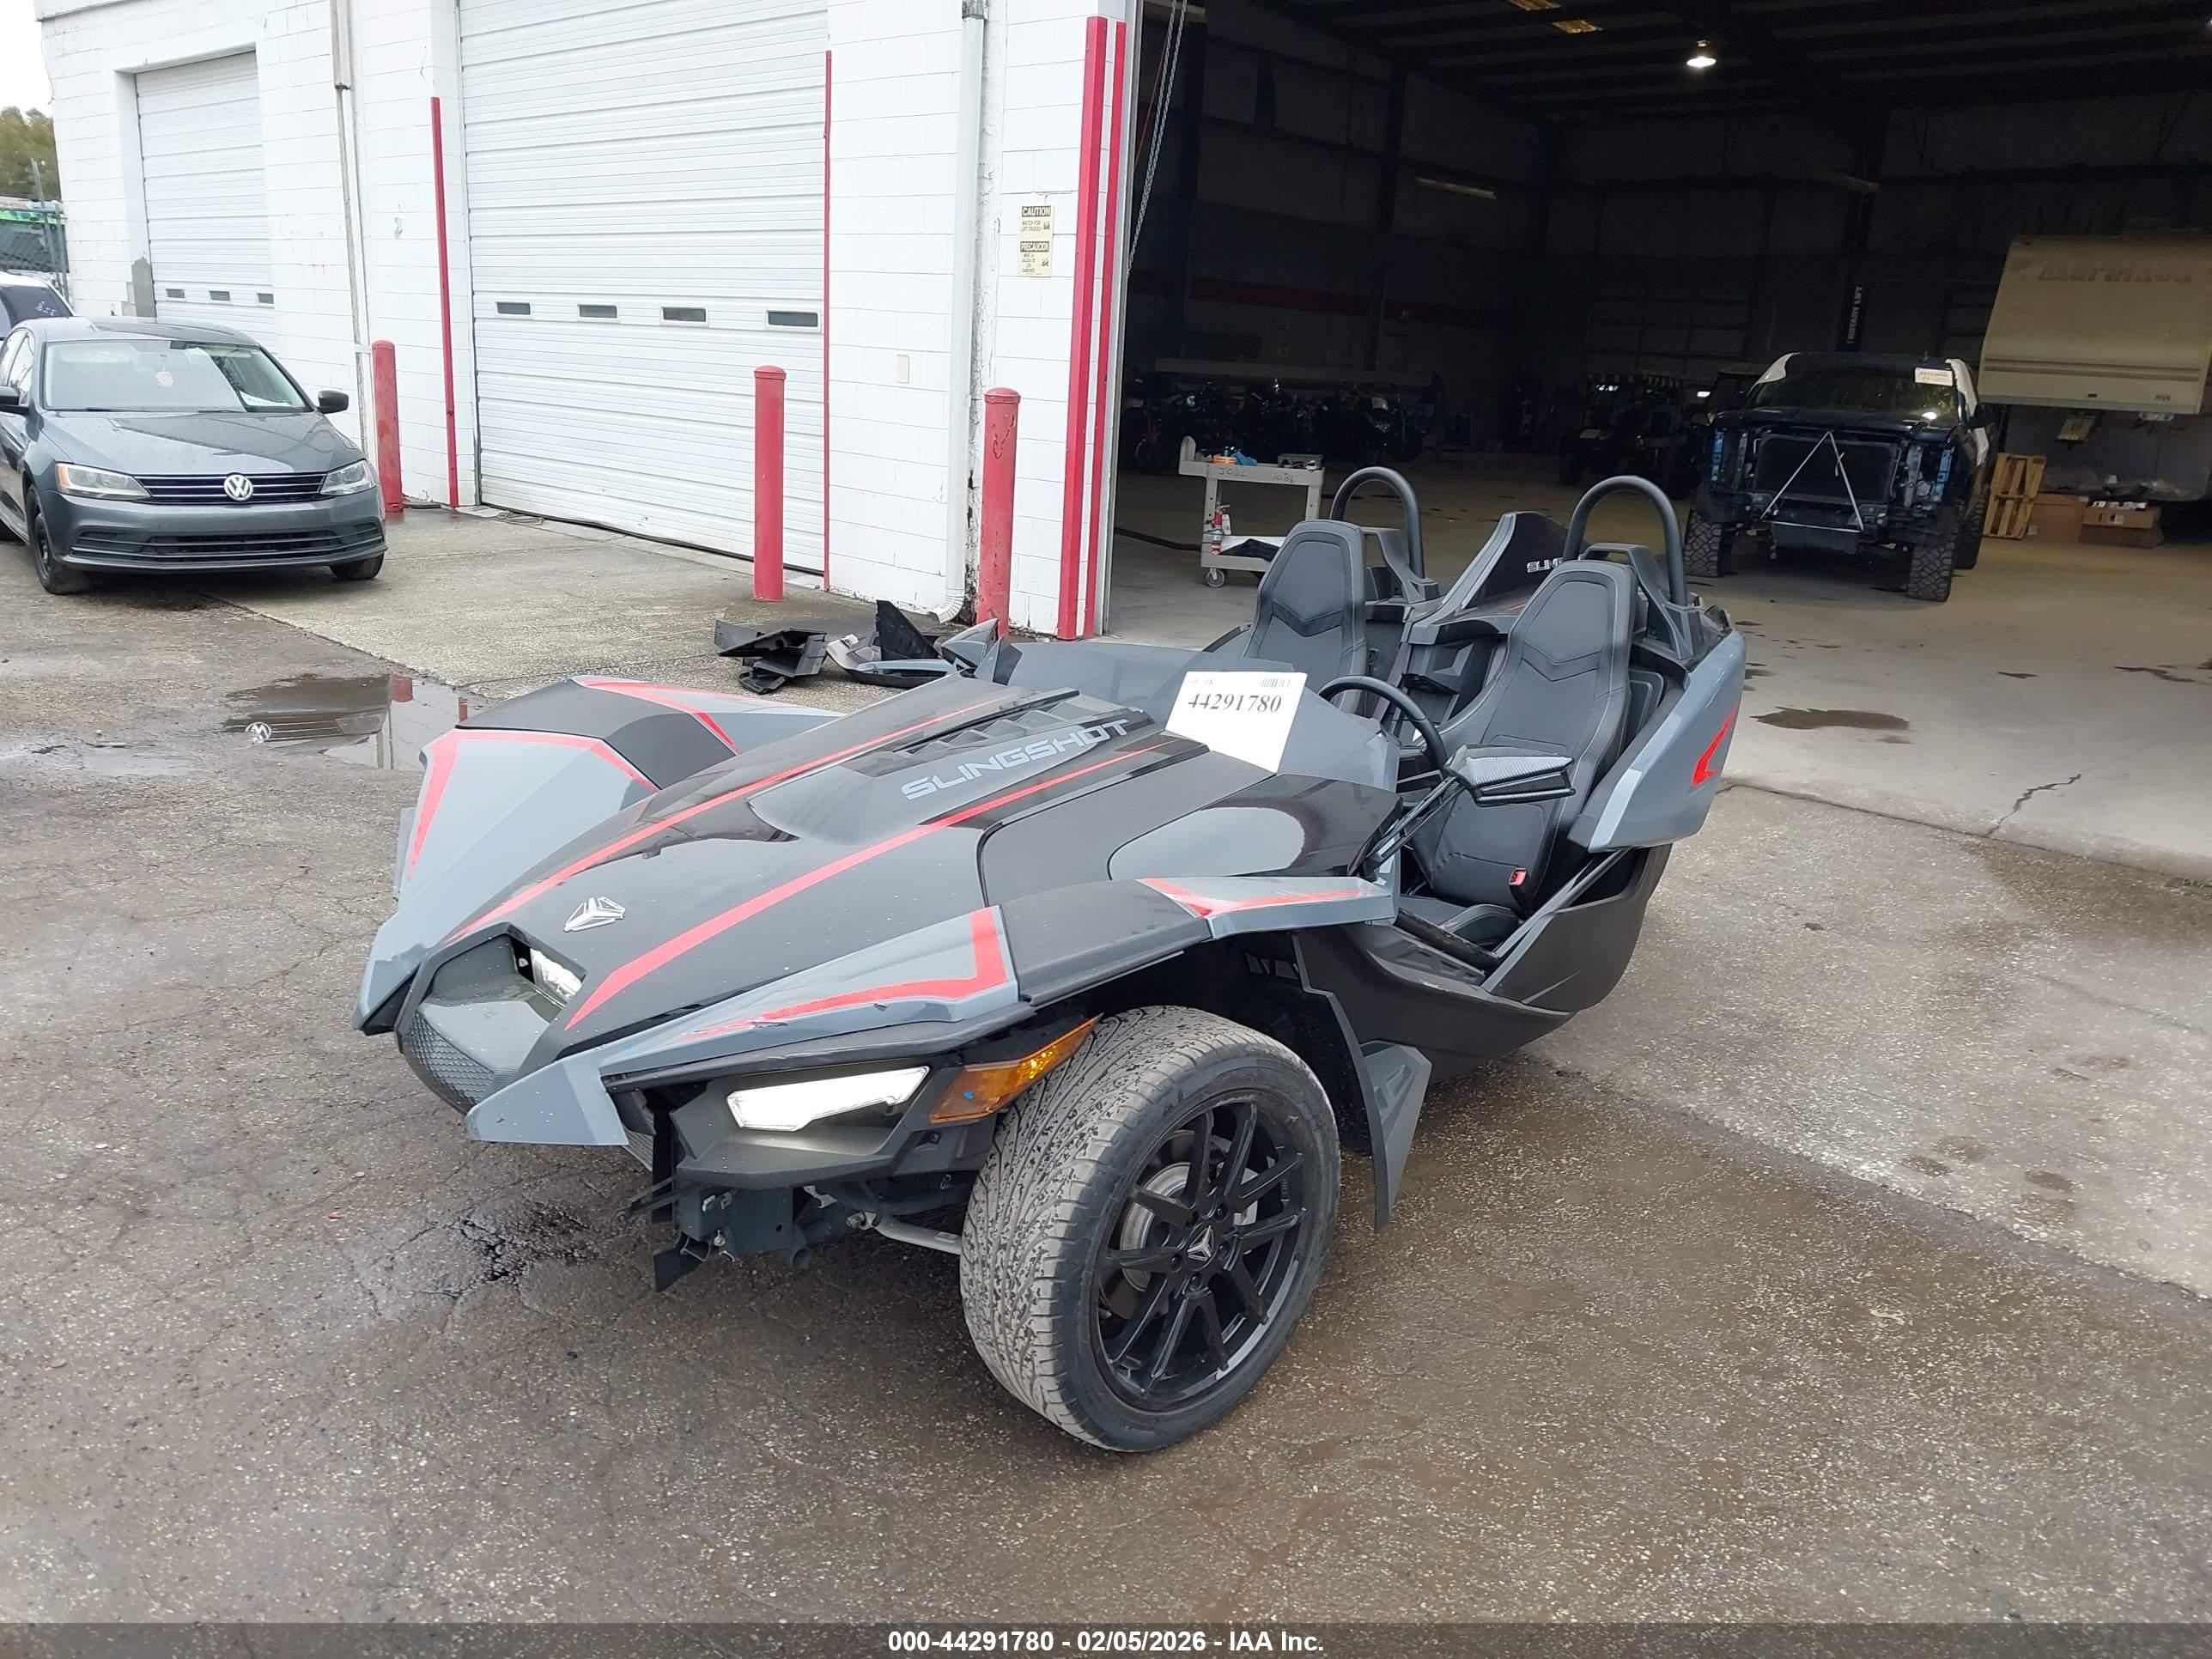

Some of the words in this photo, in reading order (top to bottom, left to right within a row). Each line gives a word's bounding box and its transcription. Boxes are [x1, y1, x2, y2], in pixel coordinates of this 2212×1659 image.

[1023, 207, 1050, 216] CAUTION
[1188, 692, 1282, 713] 44291780
[902, 719, 1129, 800] SLINGSHOT
